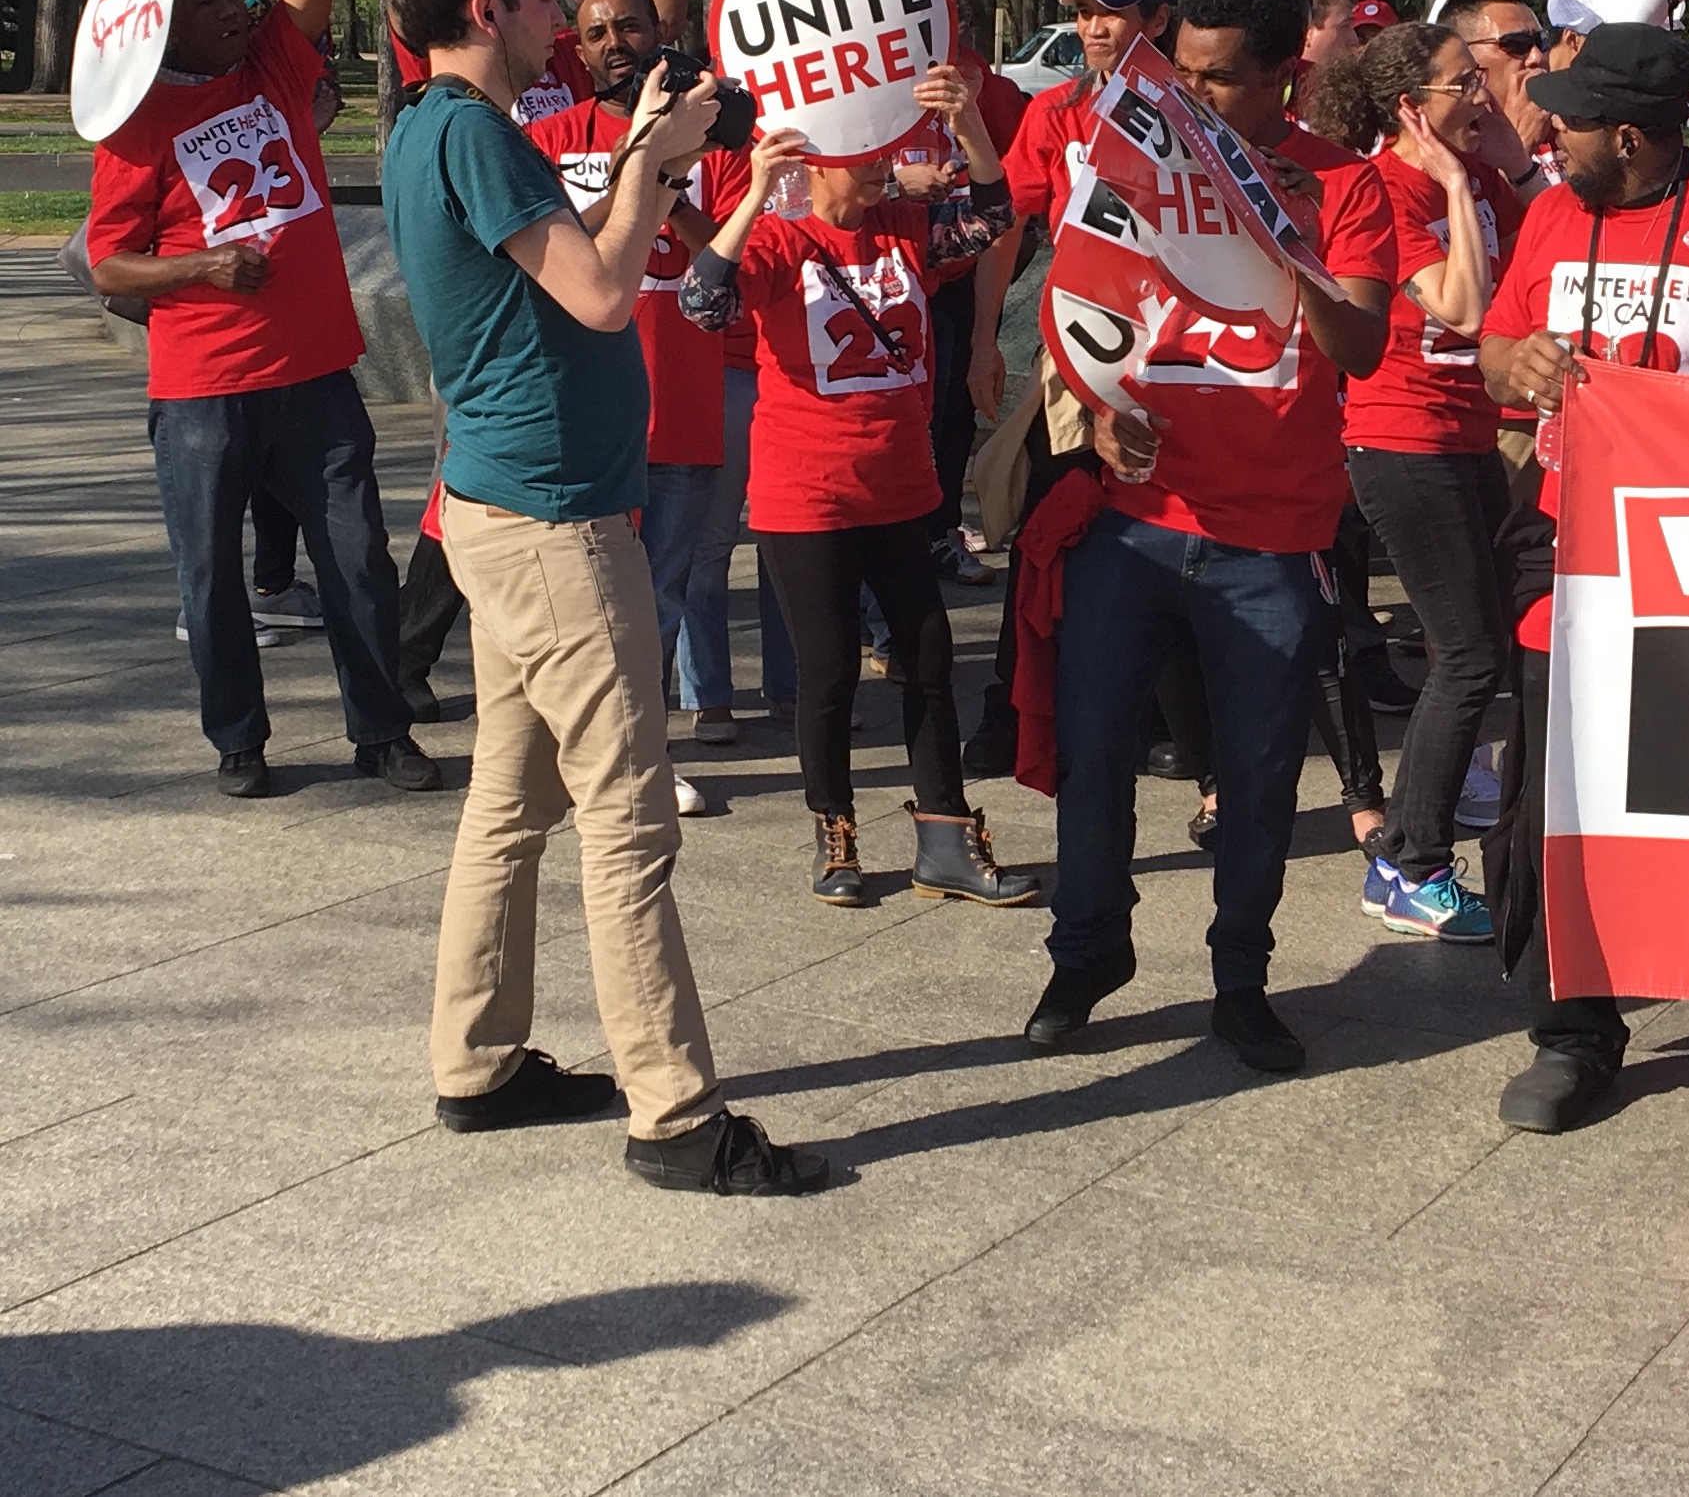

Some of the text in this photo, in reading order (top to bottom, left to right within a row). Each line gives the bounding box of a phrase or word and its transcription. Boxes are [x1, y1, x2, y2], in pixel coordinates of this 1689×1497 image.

[744, 17, 939, 118] HERE!
[199, 118, 280, 161] LOCAL
[207, 136, 304, 234] 23
[823, 299, 922, 383] 23
